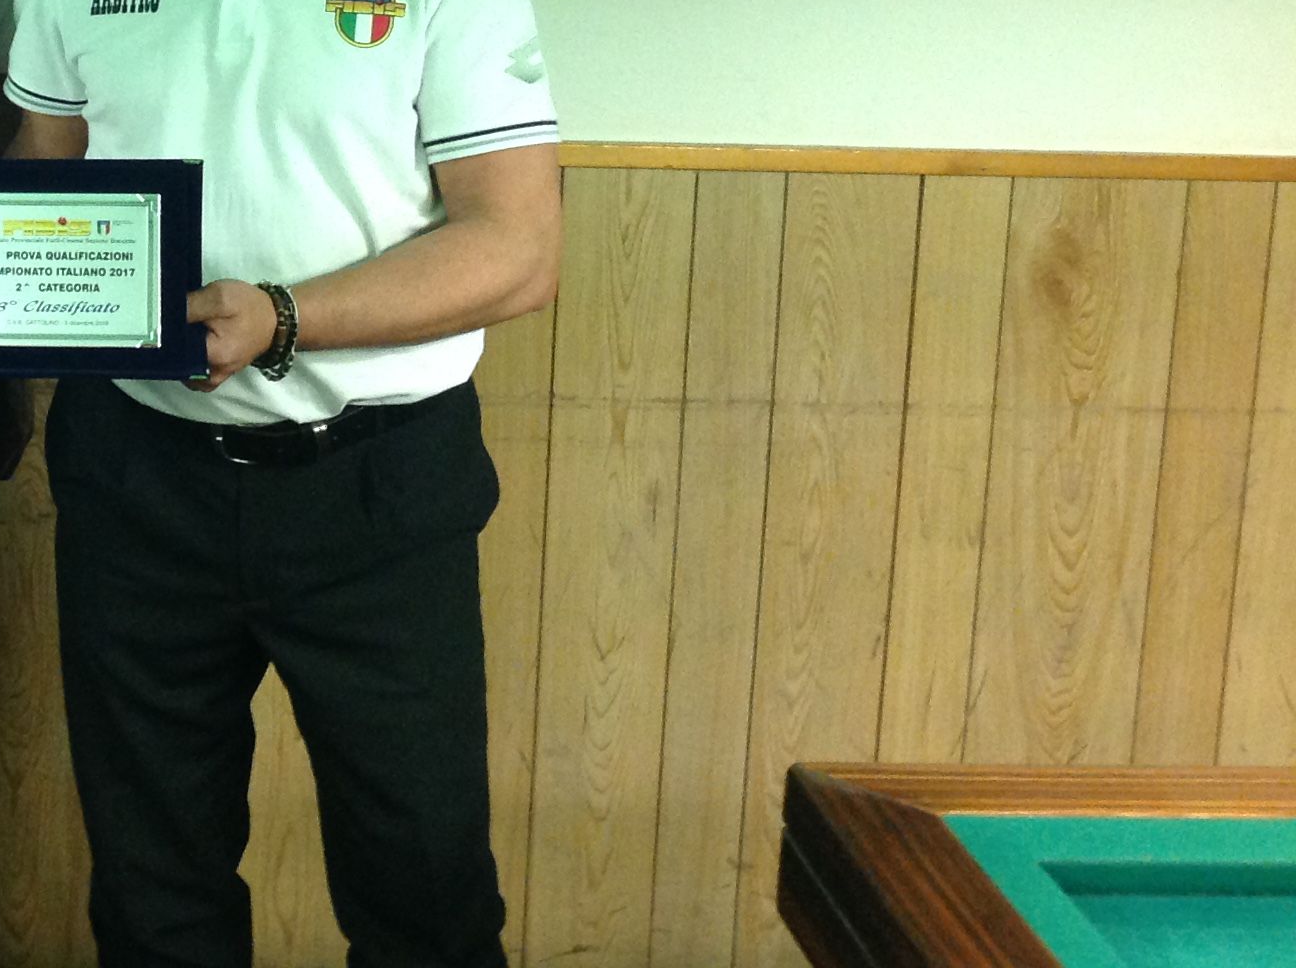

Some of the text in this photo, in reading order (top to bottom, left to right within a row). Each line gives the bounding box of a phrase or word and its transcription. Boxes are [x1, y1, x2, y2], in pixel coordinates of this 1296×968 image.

[6, 251, 42, 261] PROVA
[45, 251, 134, 261] QUALIFICAZIONI
[56, 267, 106, 277] ITALIANO
[109, 267, 136, 277] 2017
[38, 283, 100, 293] CATEGORIA
[23, 299, 121, 316] Classificato
